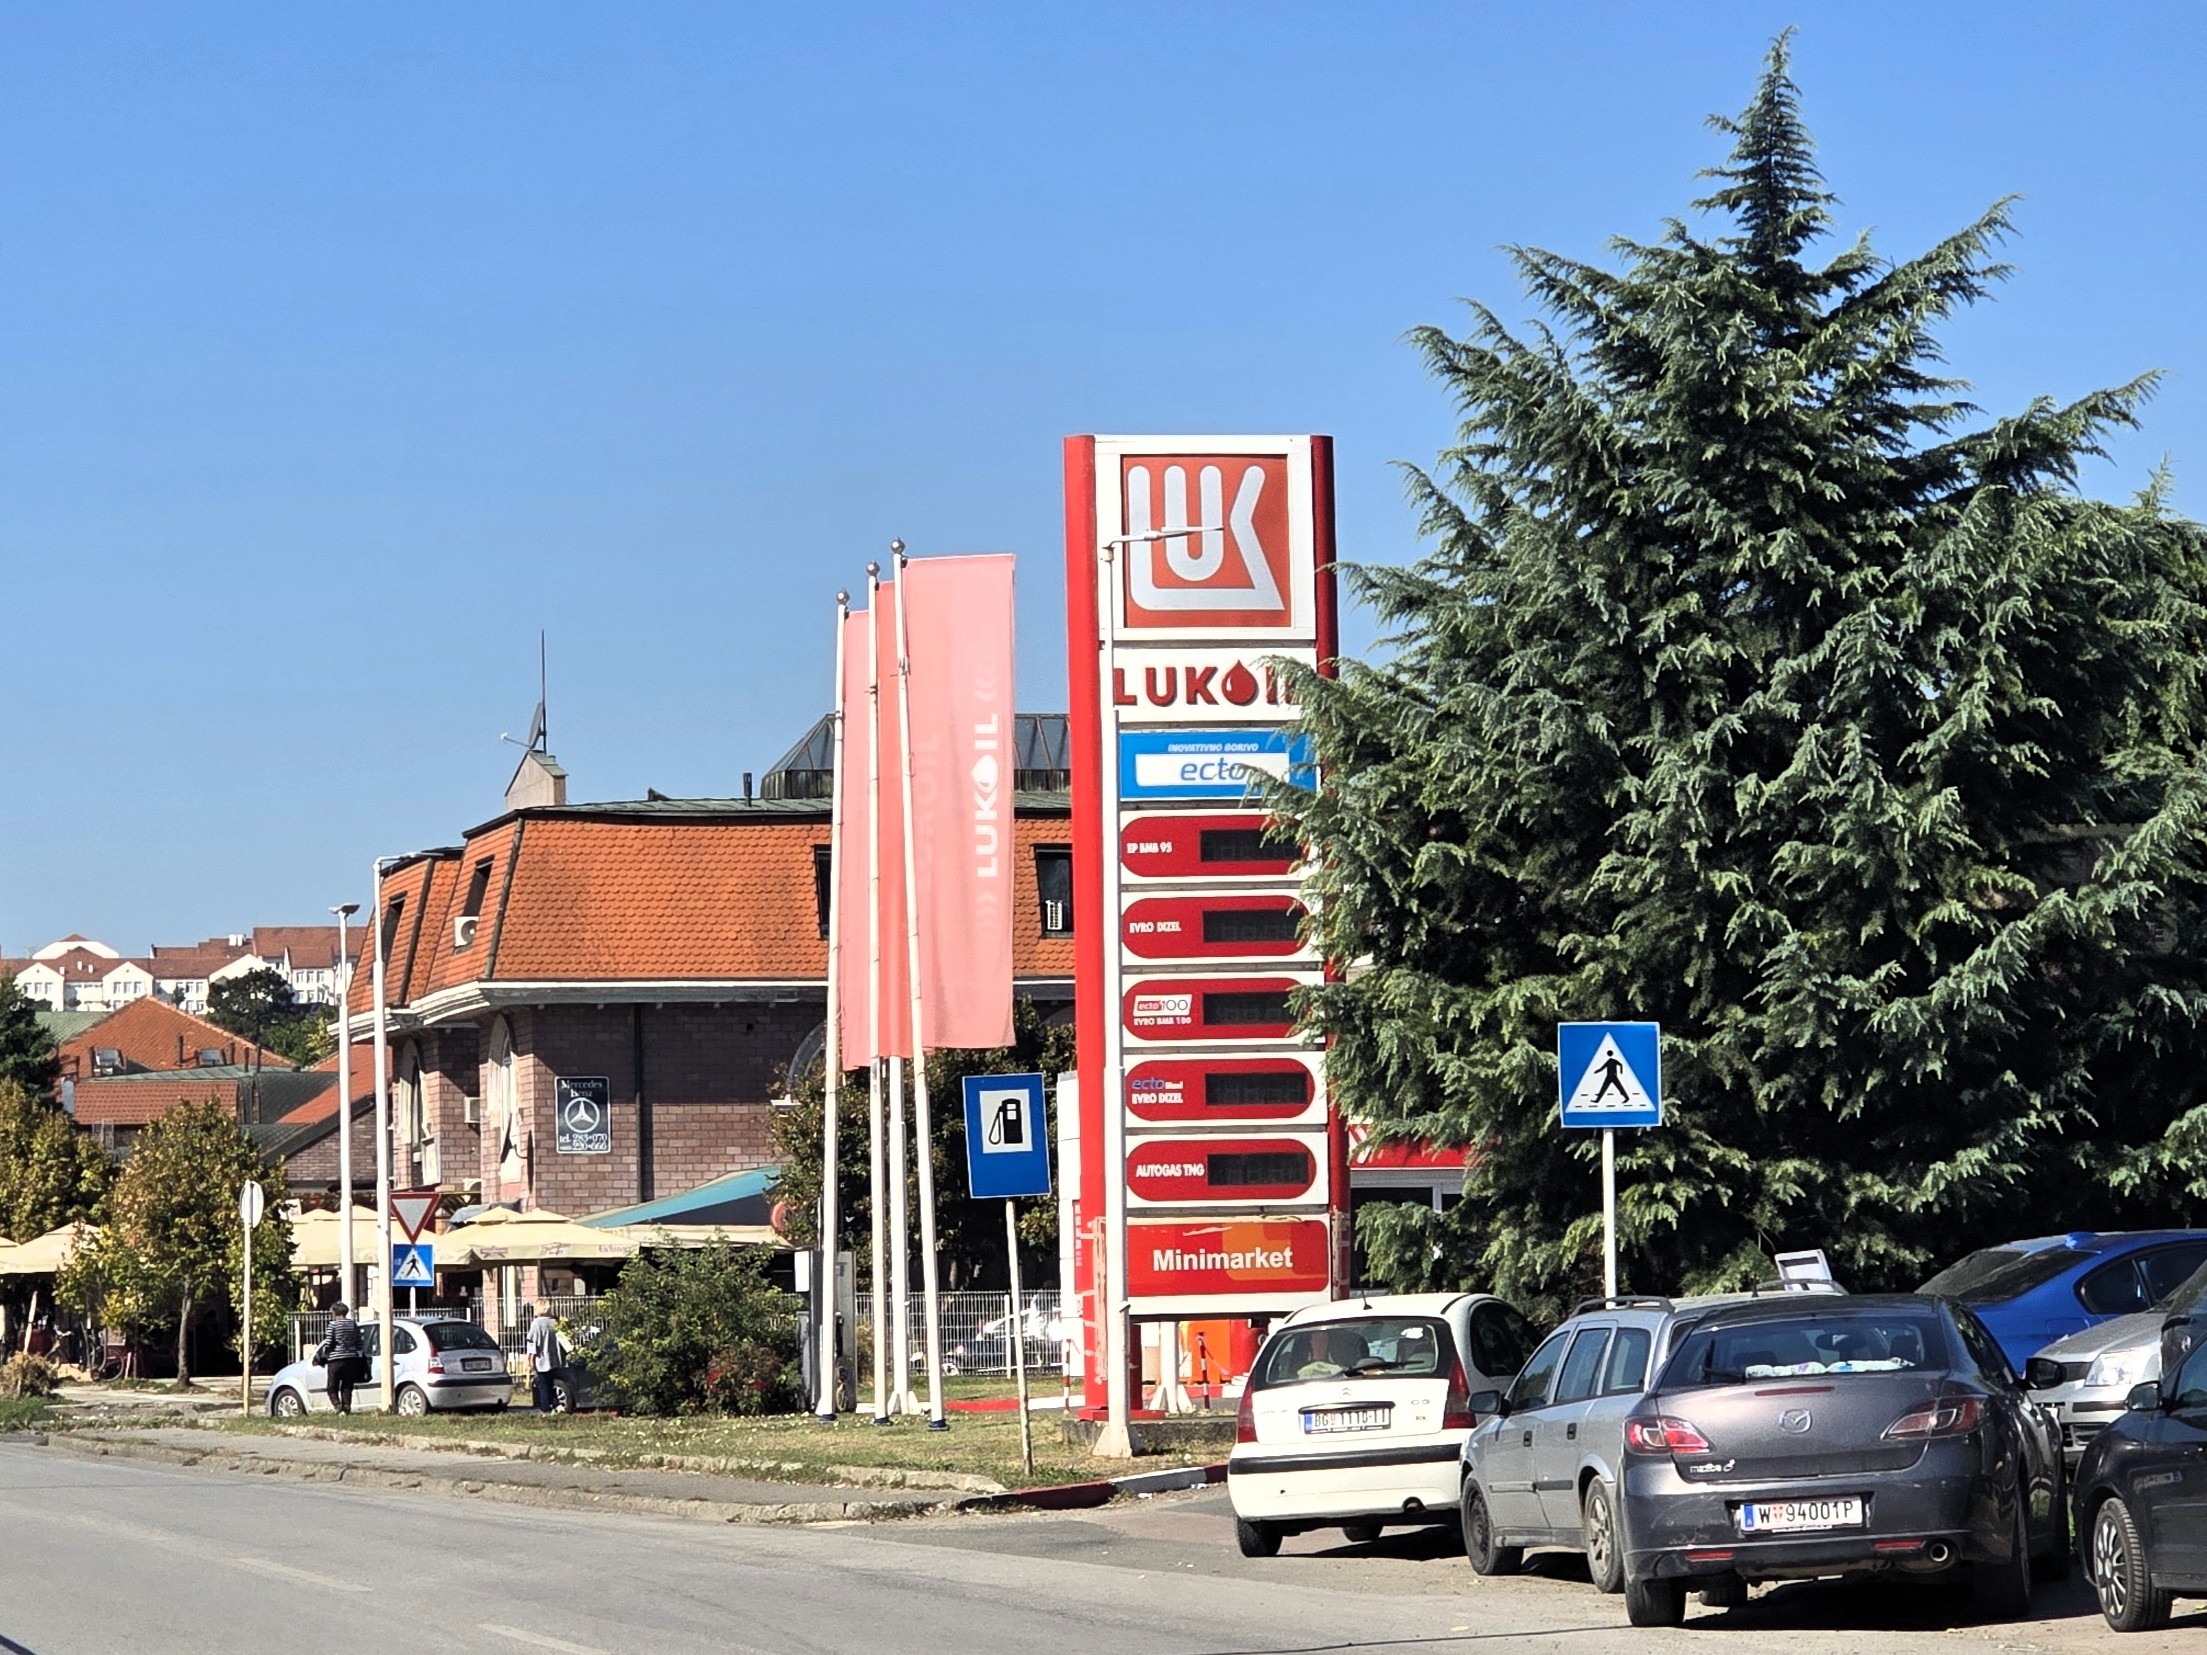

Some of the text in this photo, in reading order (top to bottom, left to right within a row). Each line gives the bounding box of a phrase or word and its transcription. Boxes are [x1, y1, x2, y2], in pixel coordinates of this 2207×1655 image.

[1181, 757, 1248, 781] ecto
[971, 713, 999, 878] LUKOIL
[1160, 841, 1173, 853] 95
[1129, 921, 1154, 933] EVRO
[1131, 1093, 1157, 1104] EVRO
[1136, 1164, 1182, 1177] AUTOGAS
[1153, 1247, 1293, 1272] Minimarket
[1759, 1507, 1771, 1524] W
[1786, 1502, 1853, 1522] 94001P
